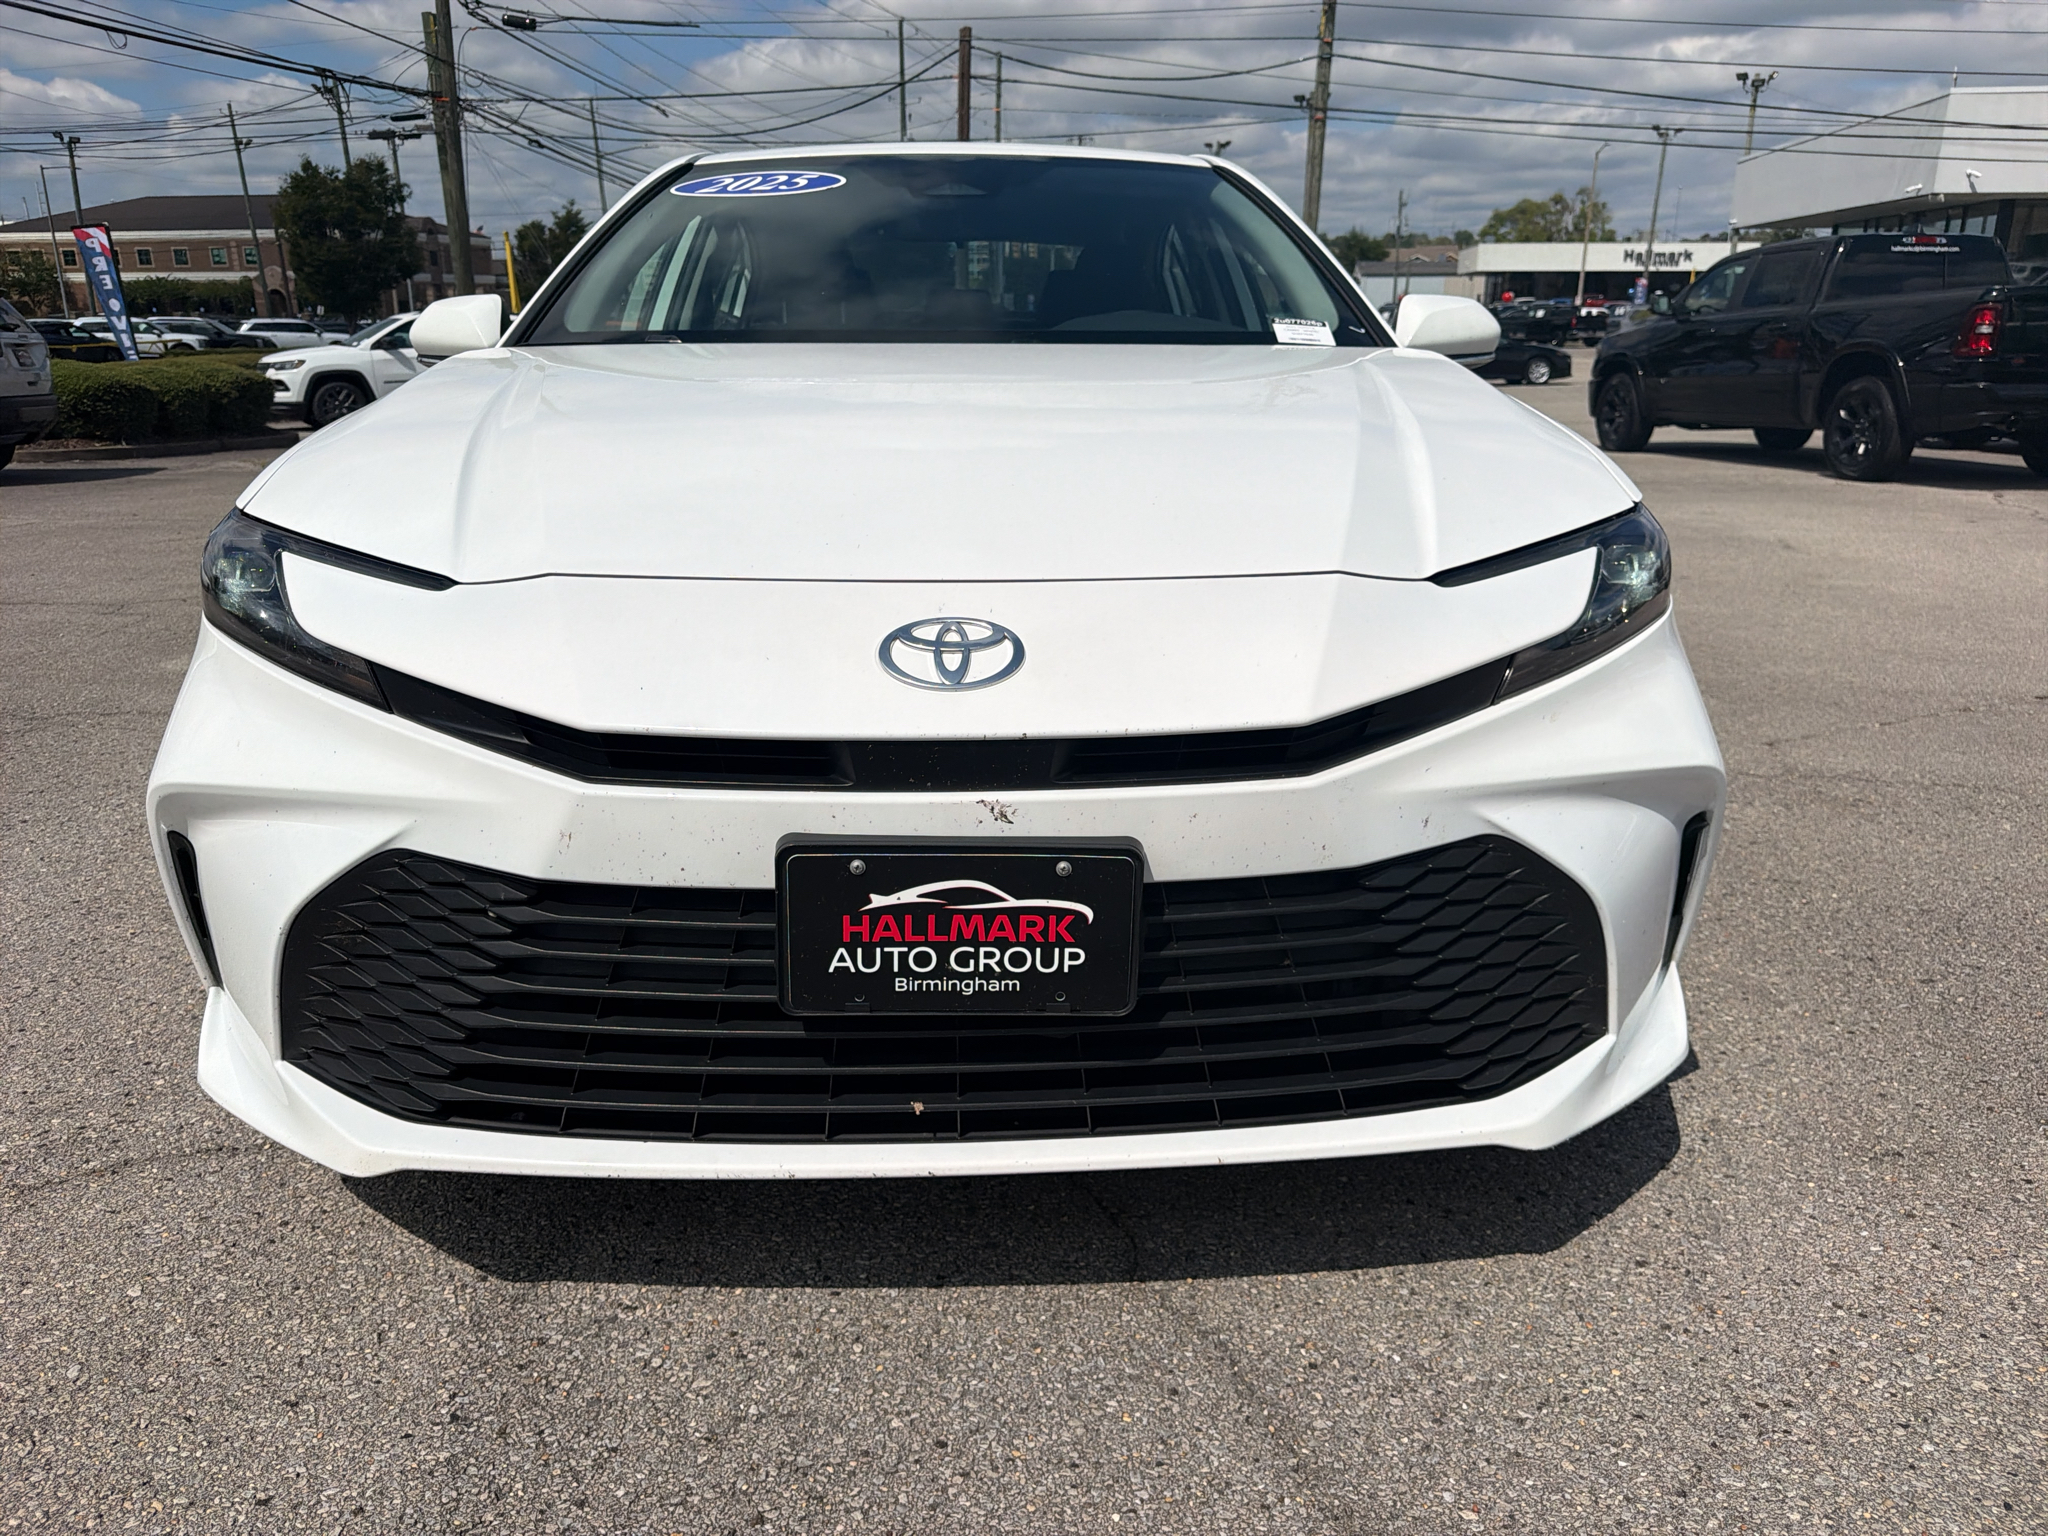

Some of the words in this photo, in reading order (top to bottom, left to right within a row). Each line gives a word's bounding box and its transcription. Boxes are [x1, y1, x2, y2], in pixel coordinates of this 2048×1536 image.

[694, 174, 821, 194] 2025
[842, 914, 1075, 942] HALLMARK
[828, 947, 938, 973] AUTO
[950, 947, 1086, 973] GROUP
[894, 977, 1020, 995] Birmingham
